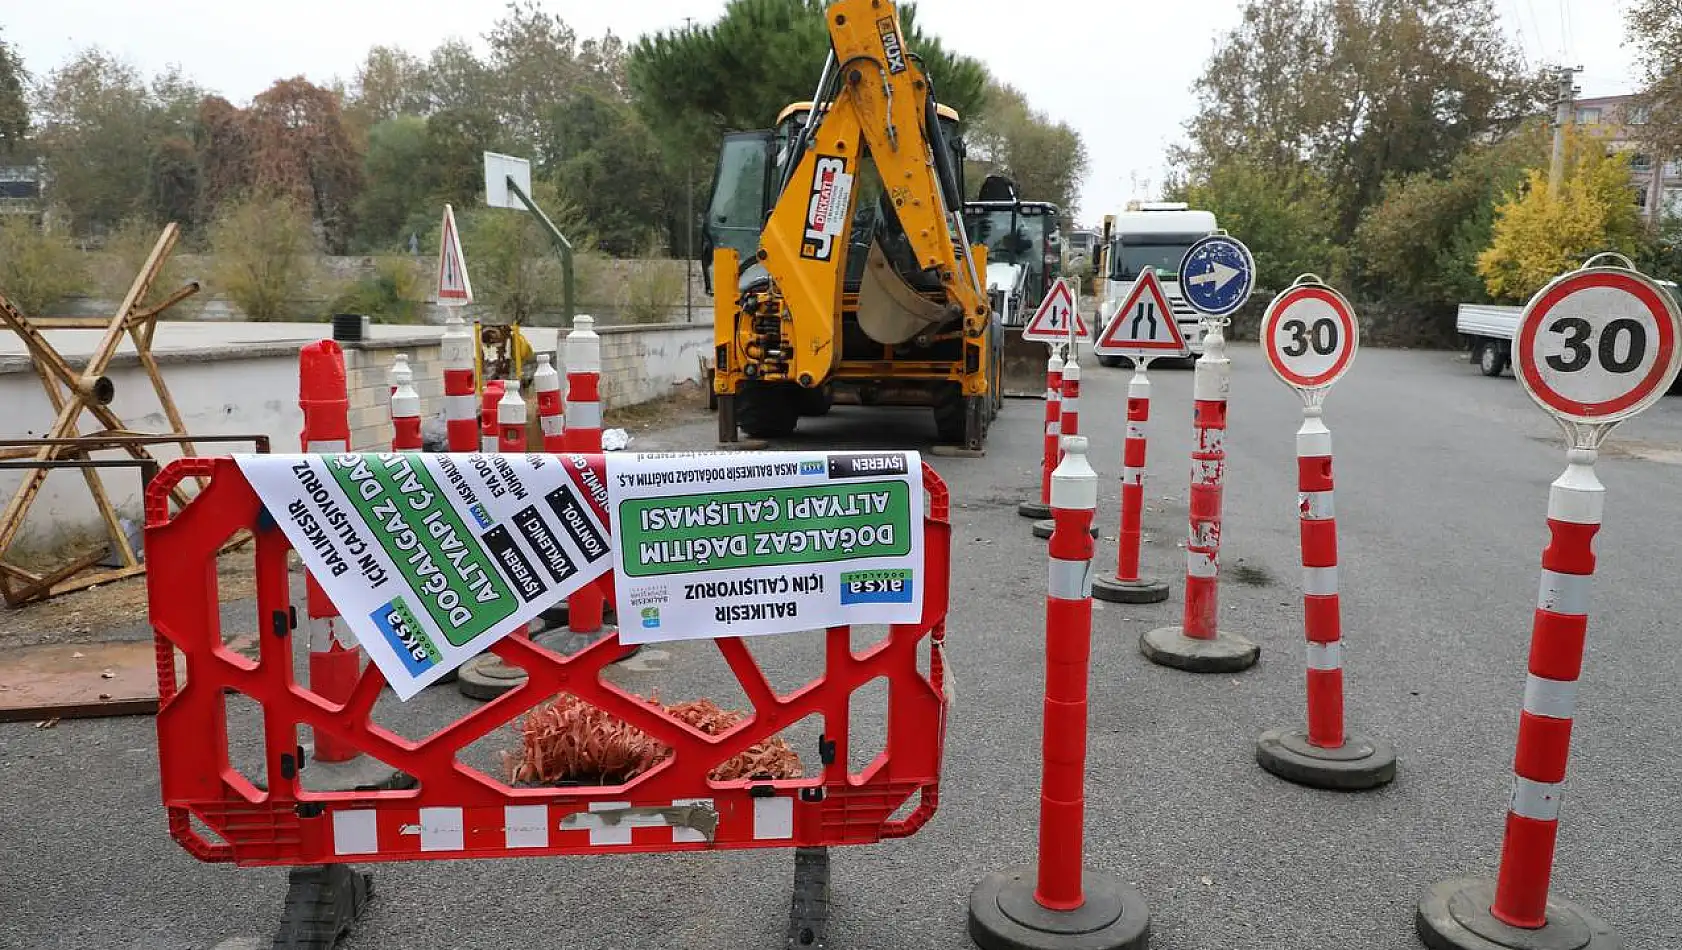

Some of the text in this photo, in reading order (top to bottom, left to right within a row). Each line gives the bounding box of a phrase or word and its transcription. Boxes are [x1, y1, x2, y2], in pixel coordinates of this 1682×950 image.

[1281, 318, 1339, 357] 30
[1545, 317, 1647, 373] 30
[616, 462, 798, 488] AKSA BALIKESİR DOĞALGAZ DAĞITIM A.Ş.
[852, 456, 903, 471] İŞVEREN
[456, 480, 478, 504] AKSA
[486, 475, 505, 498] EYA
[292, 461, 388, 588] İÇİN ÇALIŞIYORUZ
[562, 503, 602, 556] KONTROL
[642, 491, 890, 530] ALTYAPI ÇALIŞMASI
[289, 499, 348, 577] BALIKESİR
[423, 510, 499, 604] ALTYAPI
[640, 523, 893, 564] DOĞALGAZ DAĞITIM
[372, 498, 471, 627] DOĞALGAZ
[501, 548, 540, 596] İŞVEREN
[685, 573, 823, 600] İÇİN ÇALIŞIYORUZ
[850, 579, 902, 593] aksa
[715, 602, 797, 625] BALIKESİR
[388, 608, 430, 662] aksa
